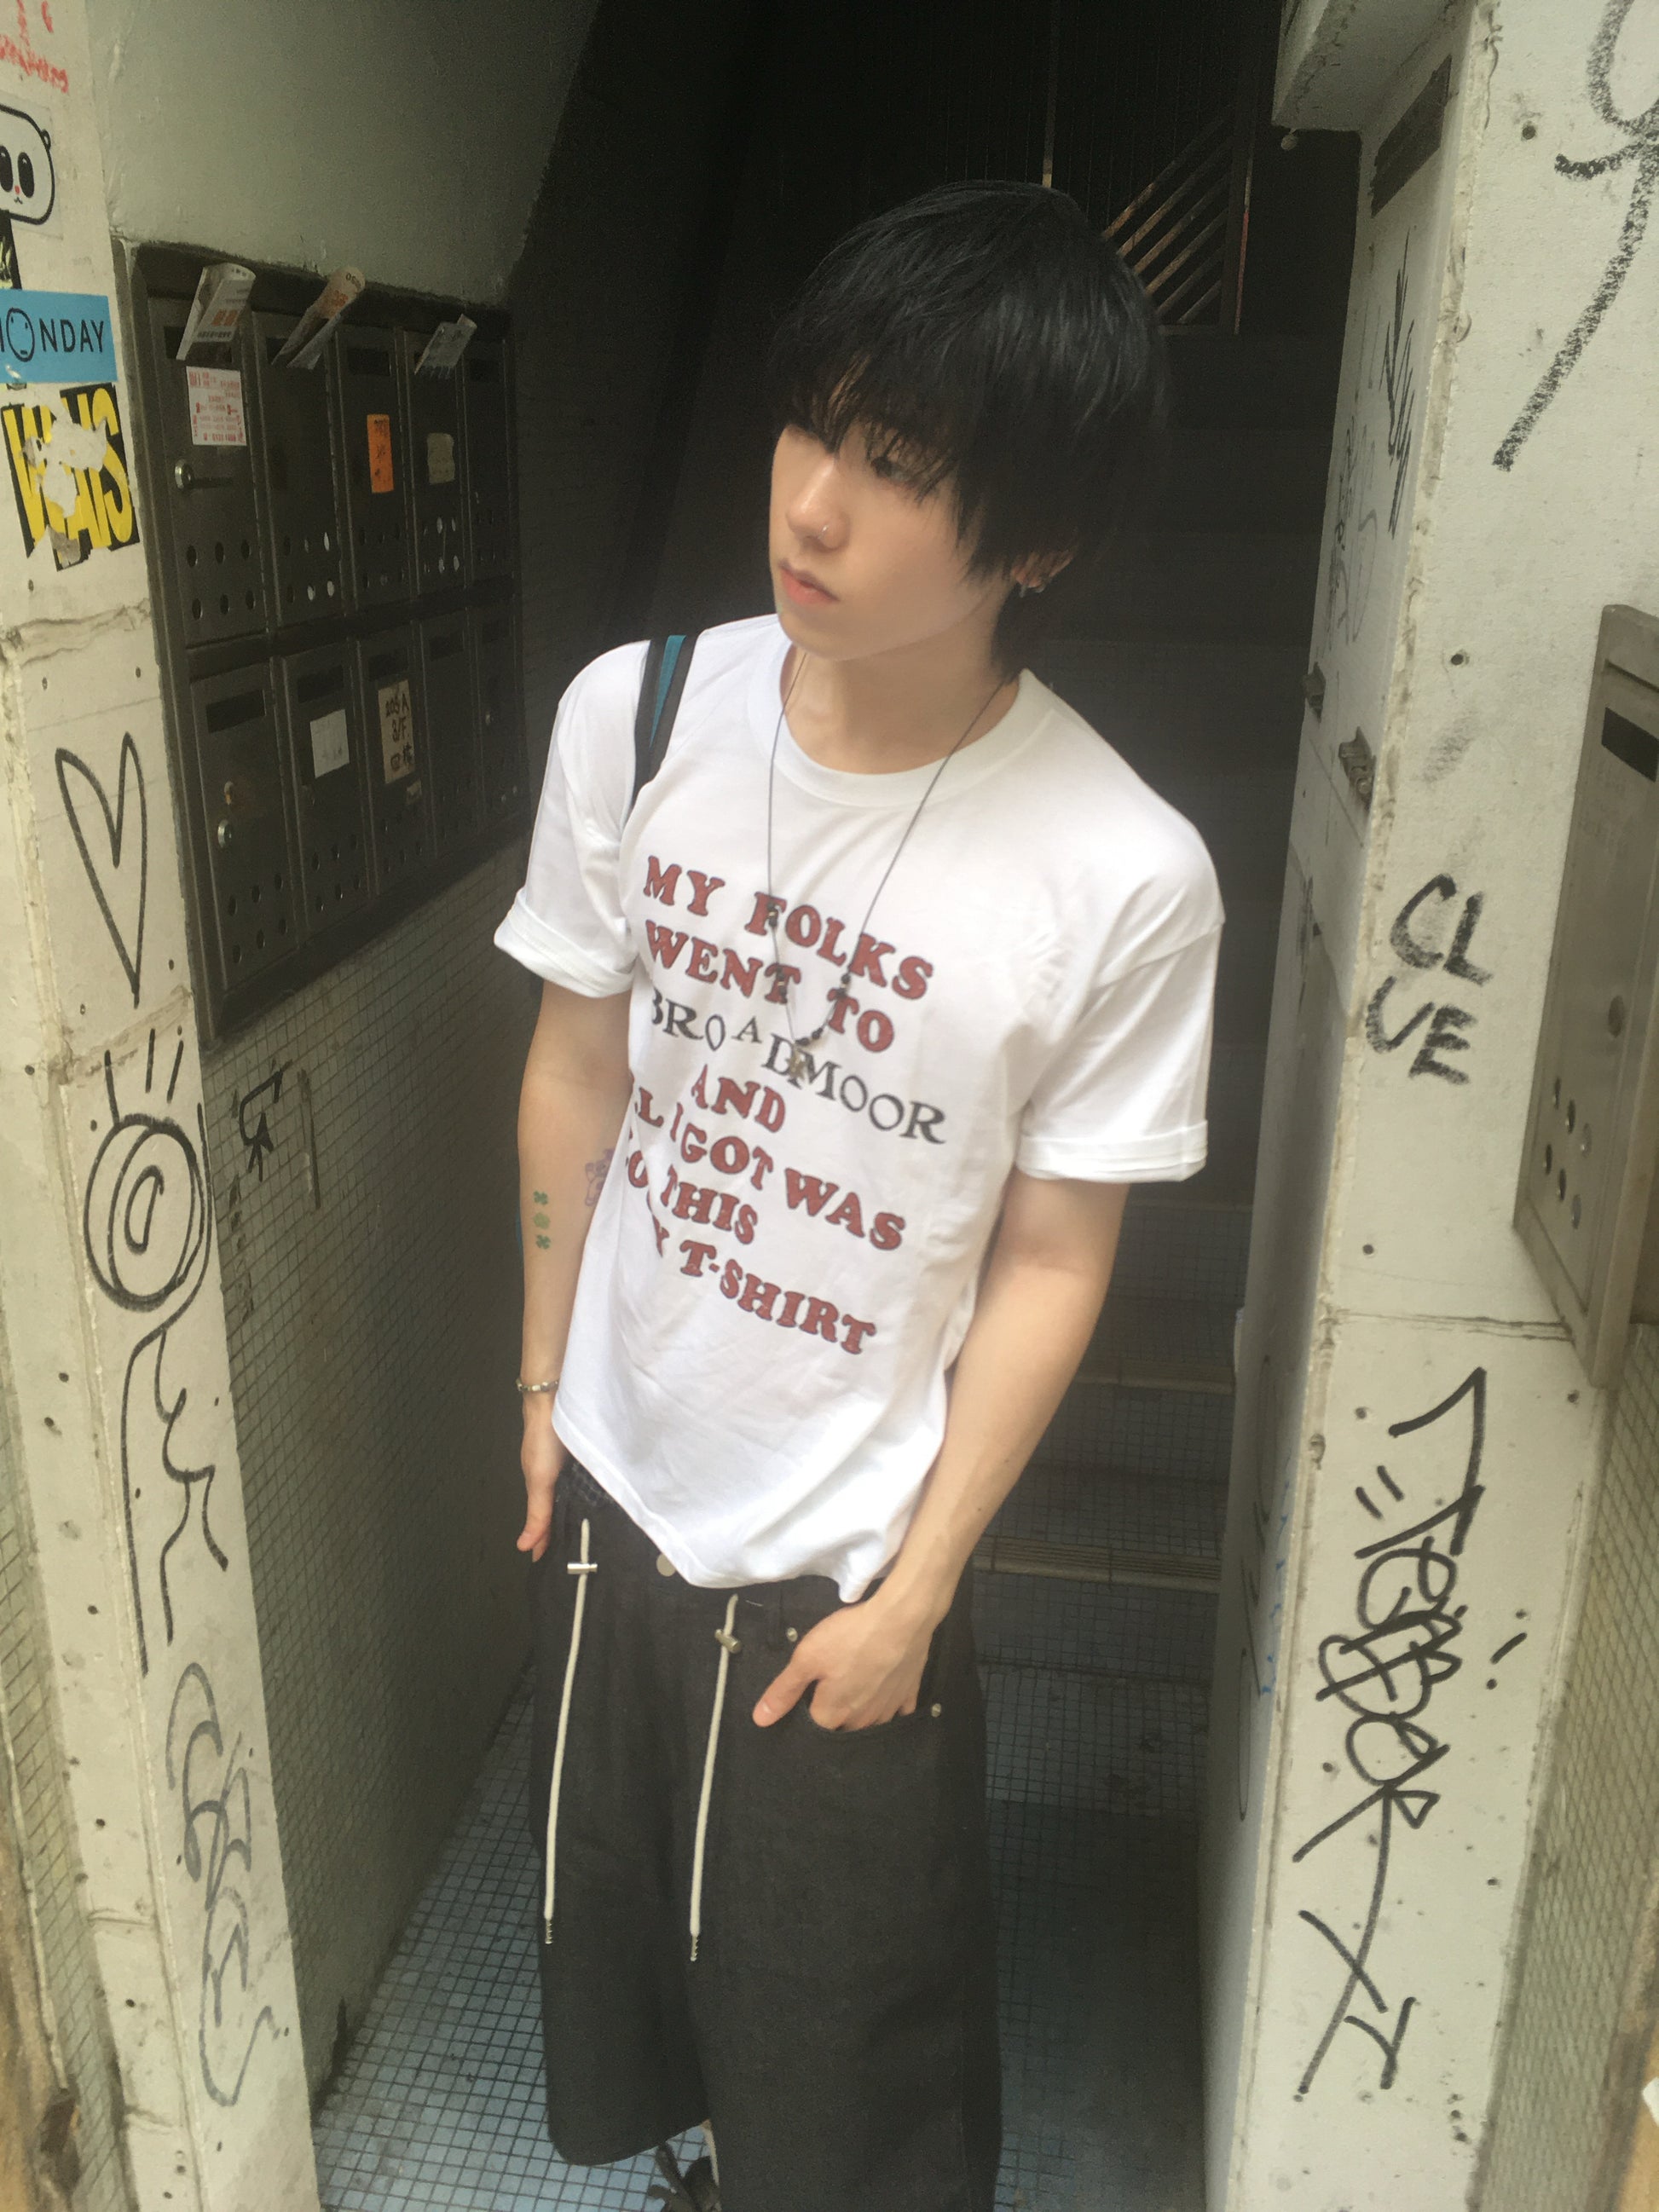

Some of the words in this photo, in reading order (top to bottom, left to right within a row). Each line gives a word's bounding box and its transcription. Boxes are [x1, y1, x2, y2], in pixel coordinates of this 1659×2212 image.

[644, 855, 725, 916] MY
[745, 892, 934, 1000] FOLKS
[645, 920, 801, 1005] WENT
[827, 987, 893, 1053] TO
[651, 987, 946, 1145] BROADMOOR
[691, 1064, 786, 1133] AND
[680, 1123, 774, 1190] GOT
[784, 1167, 905, 1250] WAS
[679, 1239, 876, 1354] T-SHIRT
